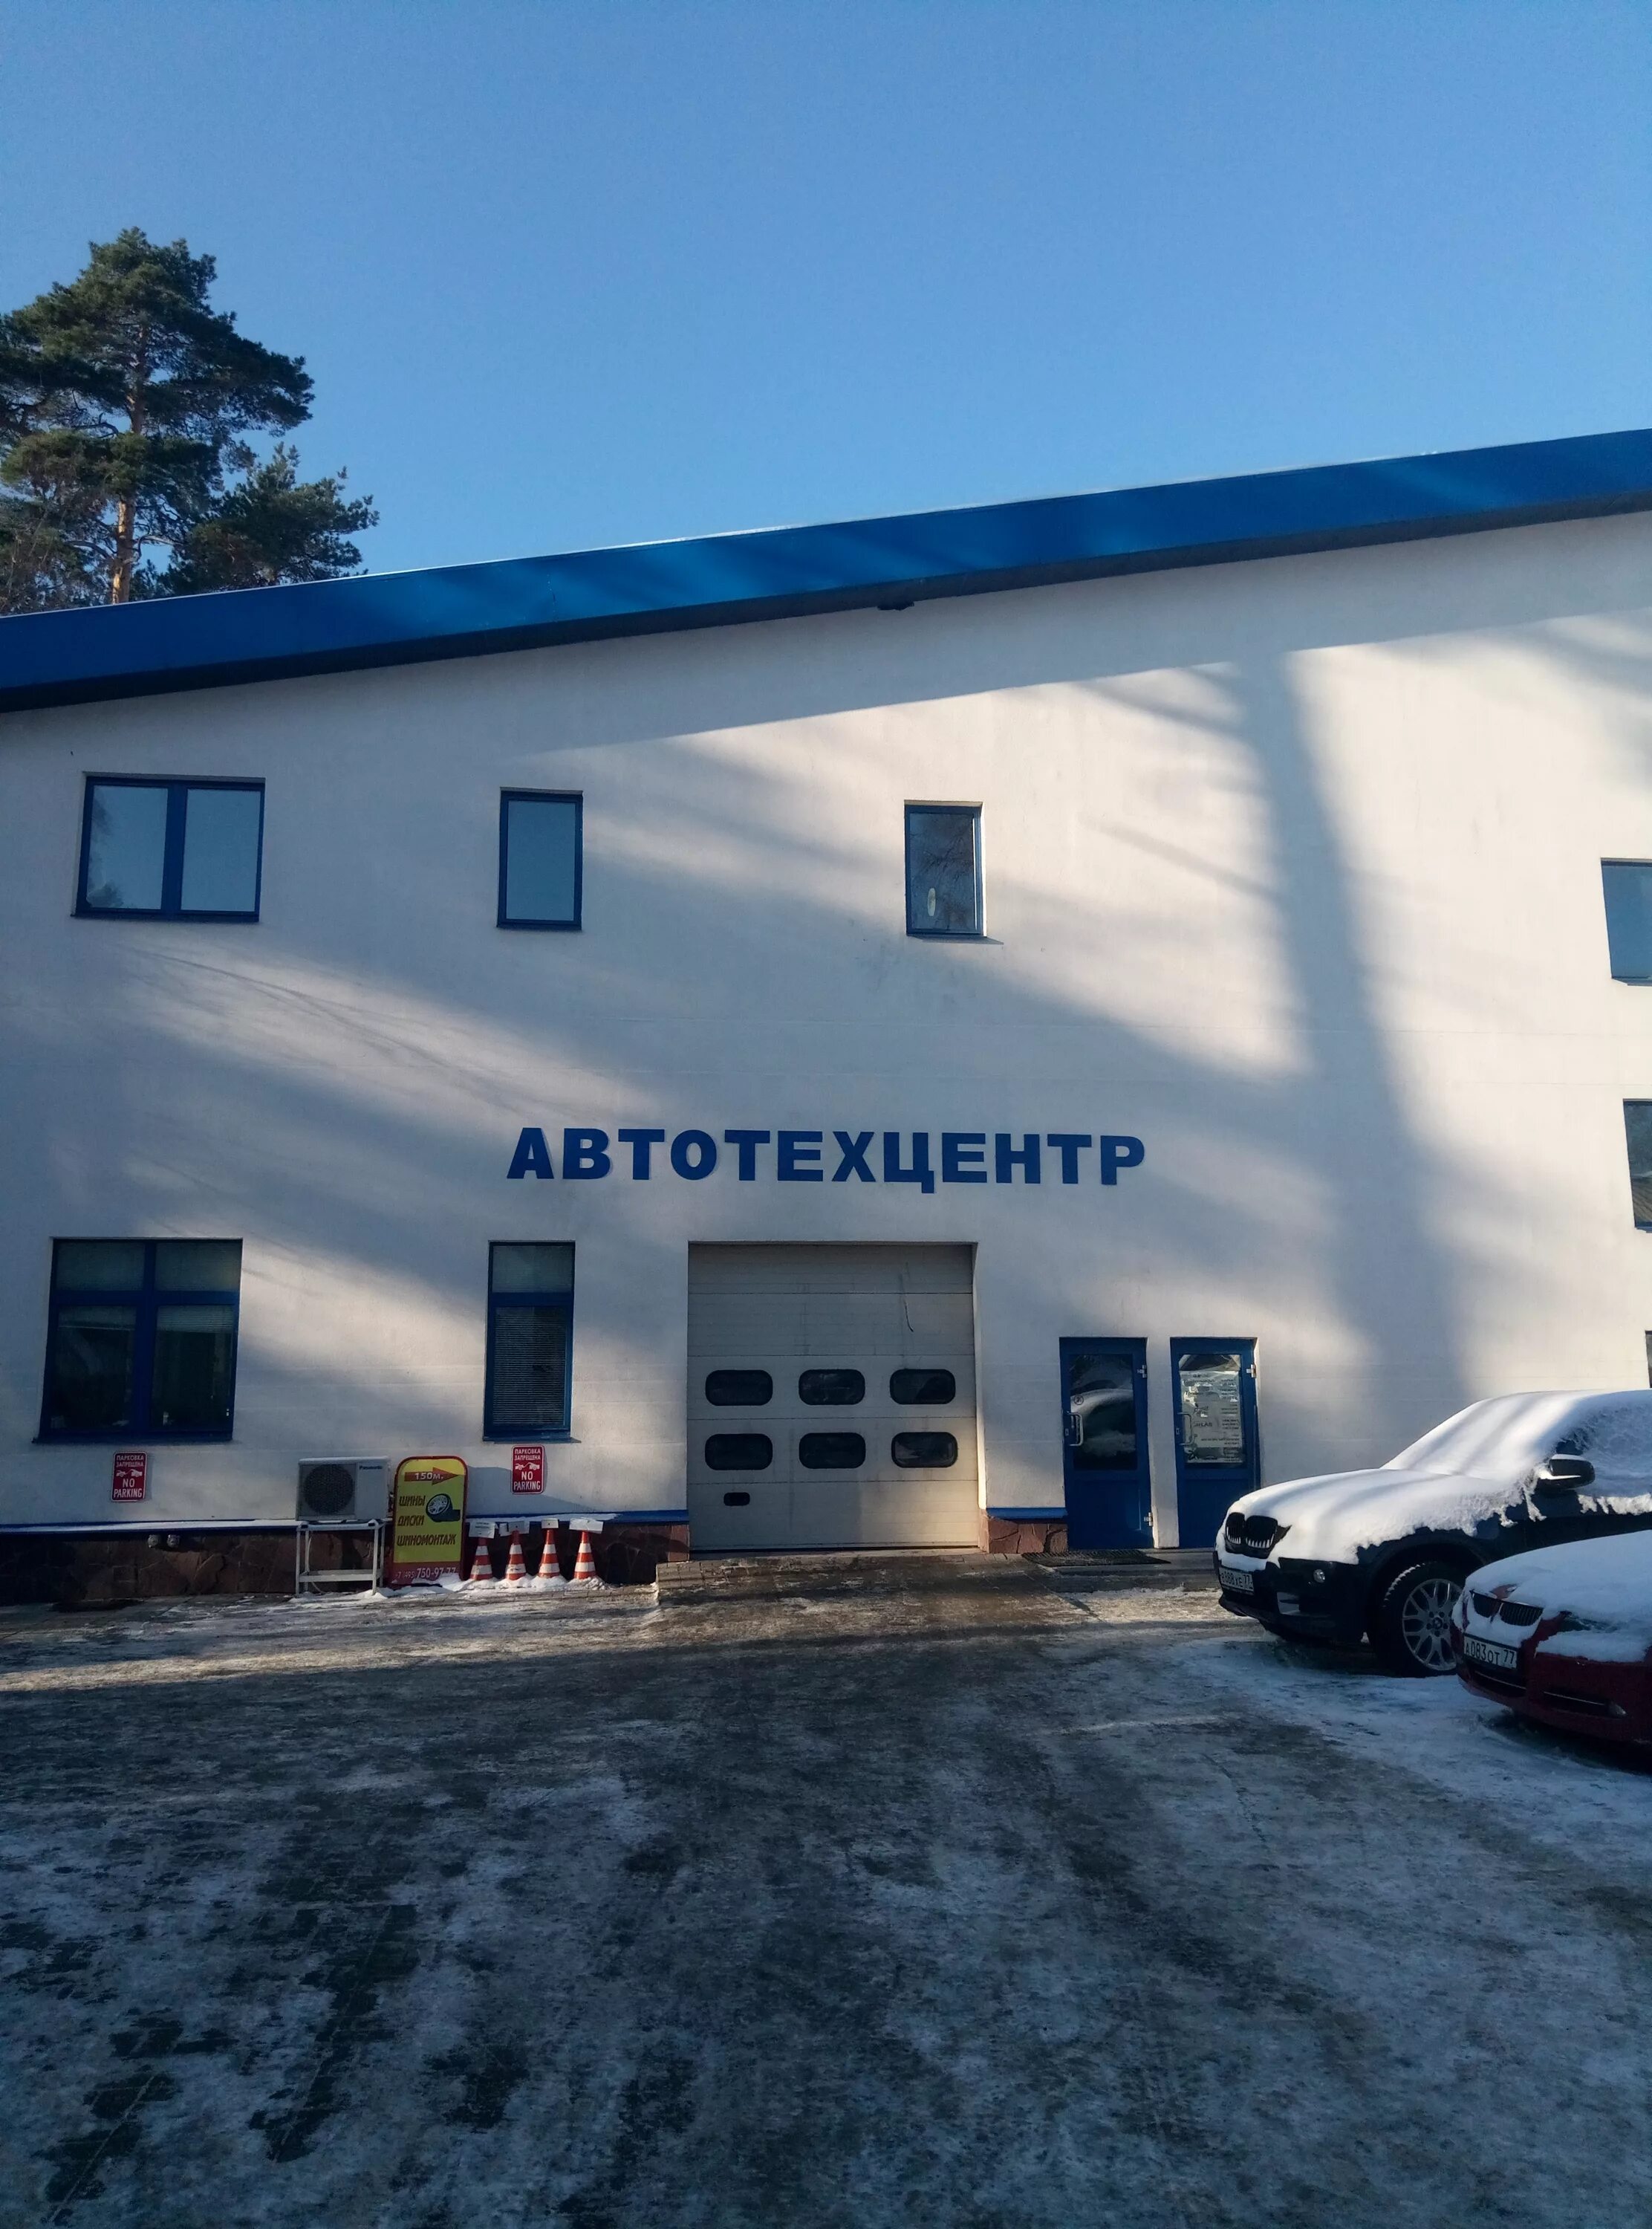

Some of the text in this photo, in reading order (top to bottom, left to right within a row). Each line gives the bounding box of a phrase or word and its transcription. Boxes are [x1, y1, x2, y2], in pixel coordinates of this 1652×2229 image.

[507, 1127, 1145, 1194] АВТОТЕХЦЕНТР
[521, 1471, 533, 1480] NO
[123, 1478, 135, 1487] NO
[513, 1481, 541, 1490] PARKING
[114, 1488, 143, 1498] PARKING
[399, 1495, 426, 1507] ШИНЫ
[397, 1515, 425, 1527] ДИСКИ
[396, 1534, 457, 1546] ШИНОМОНТАЖ
